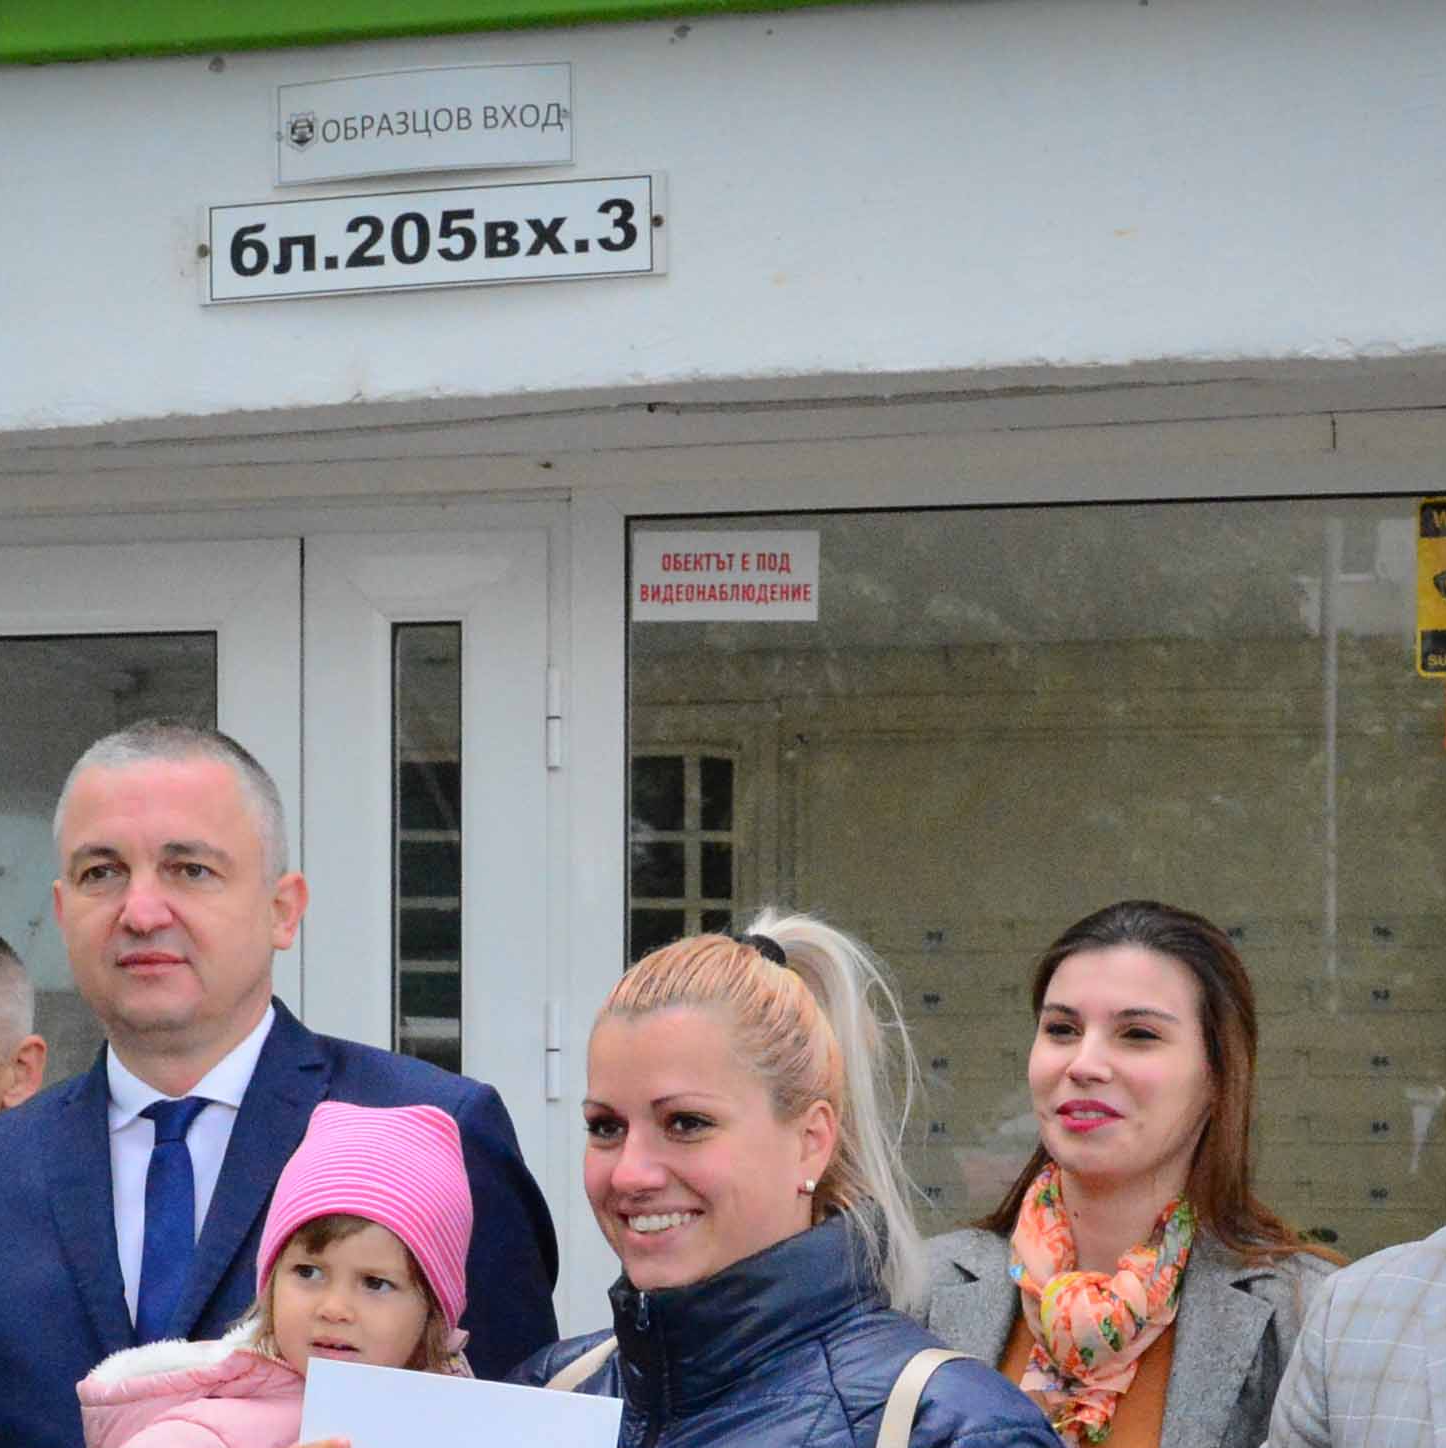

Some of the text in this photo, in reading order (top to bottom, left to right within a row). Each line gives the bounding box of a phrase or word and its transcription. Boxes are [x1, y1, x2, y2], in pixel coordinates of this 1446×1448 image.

[321, 102, 564, 145] ОБРАЗЦОВ ВХОД
[229, 197, 638, 278] бл.205вх.3
[661, 552, 792, 574] ОБЕКТЪТ Е ПОД
[639, 583, 813, 605] ВИДЕОНАБЛЮДЕНИЕ
